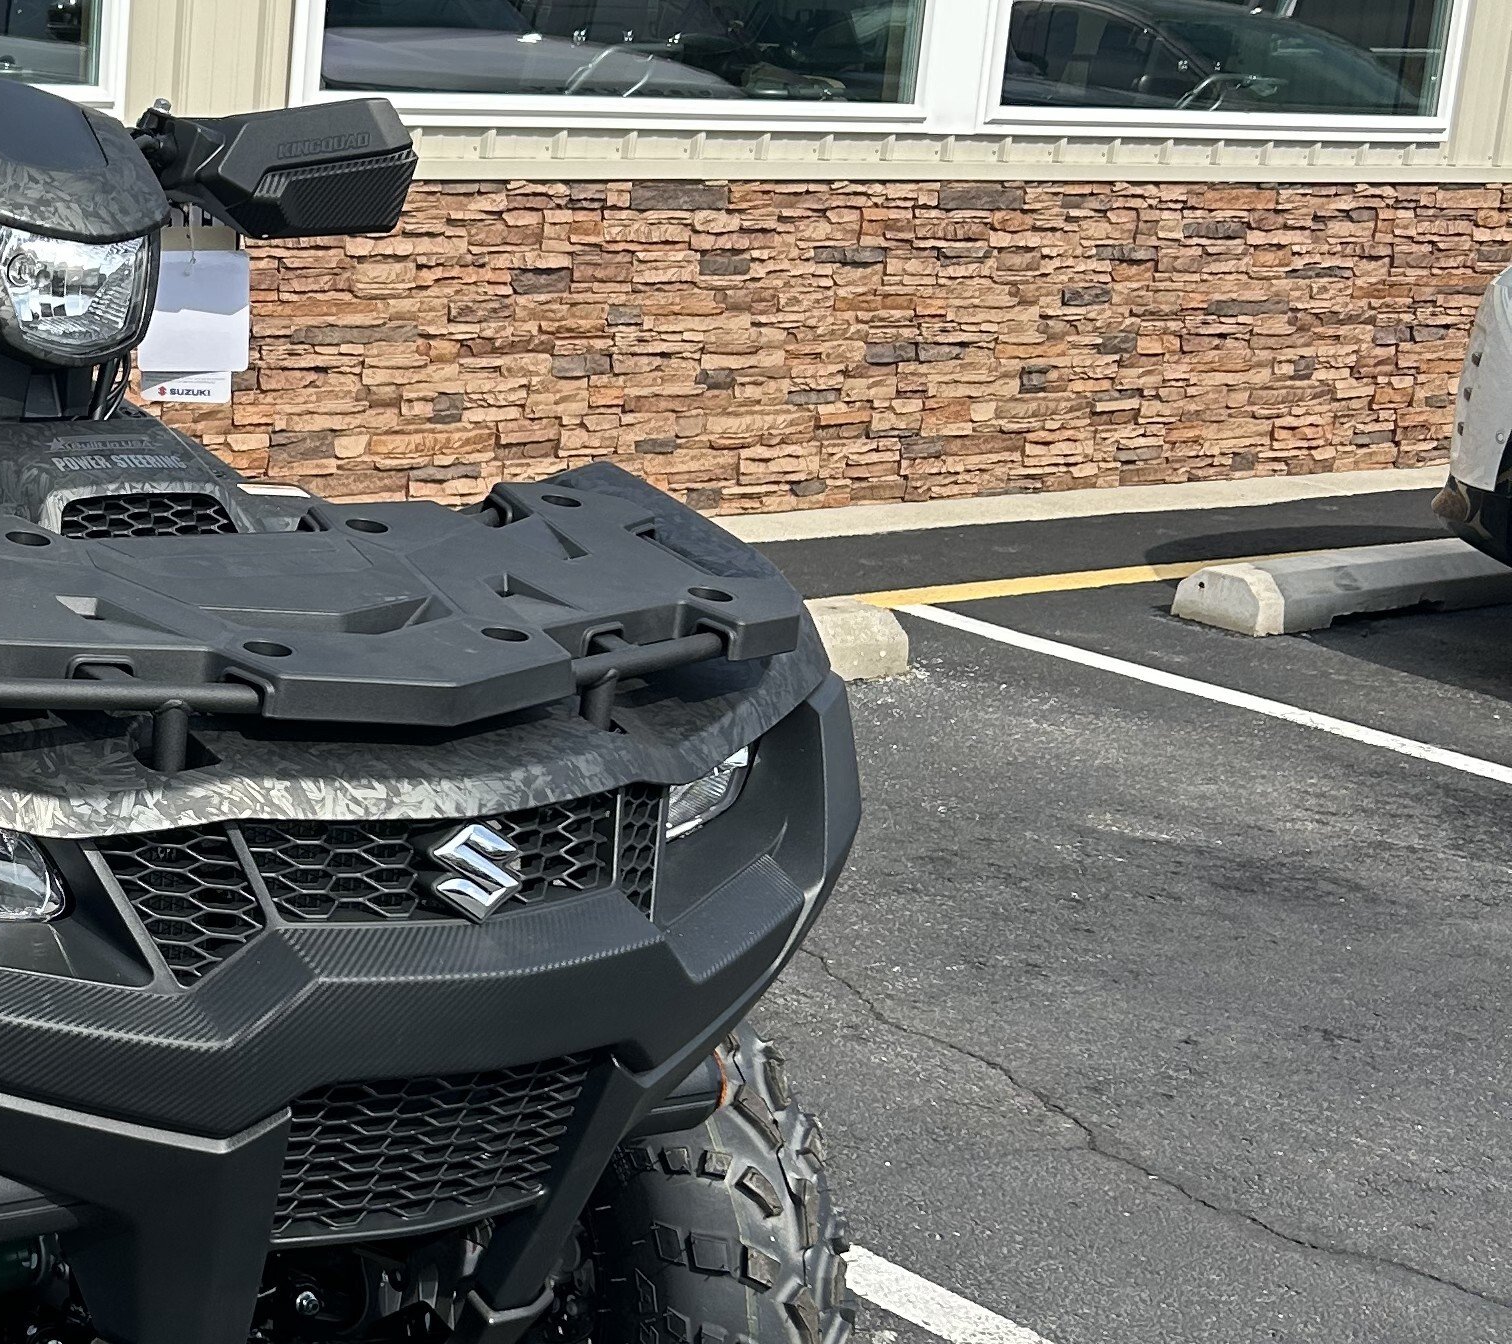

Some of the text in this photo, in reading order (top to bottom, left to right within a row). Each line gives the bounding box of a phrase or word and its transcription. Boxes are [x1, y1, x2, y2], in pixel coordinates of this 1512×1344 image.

[169, 388, 211, 397] SUZUKI
[51, 454, 188, 472] POWER STEERING
